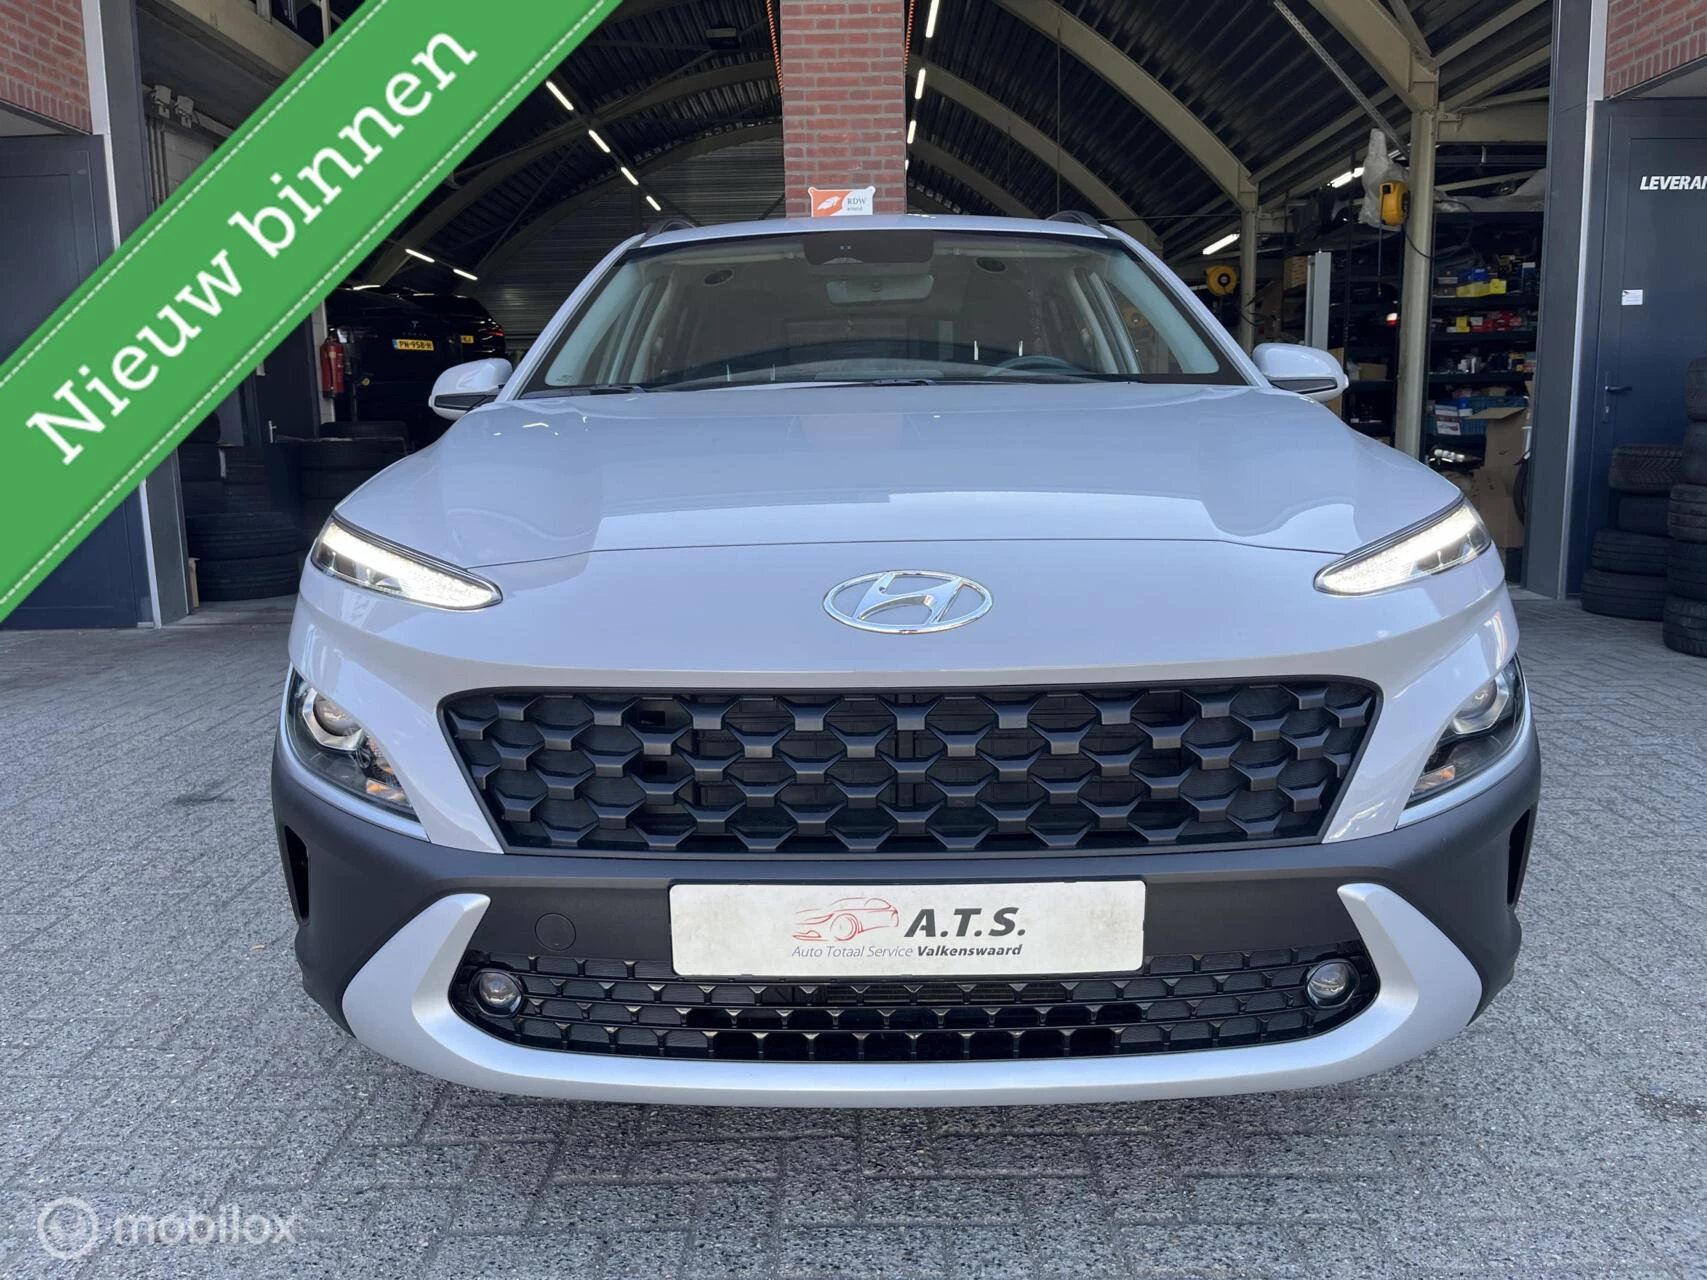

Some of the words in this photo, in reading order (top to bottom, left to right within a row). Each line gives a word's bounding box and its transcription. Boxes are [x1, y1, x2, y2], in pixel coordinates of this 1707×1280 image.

[847, 197, 867, 205] RDW
[903, 907, 1026, 938] A.T.S.
[791, 945, 823, 958] Auto
[826, 945, 864, 958] Totaal
[867, 945, 913, 958] Service
[917, 944, 1022, 957] Valkenswaard
